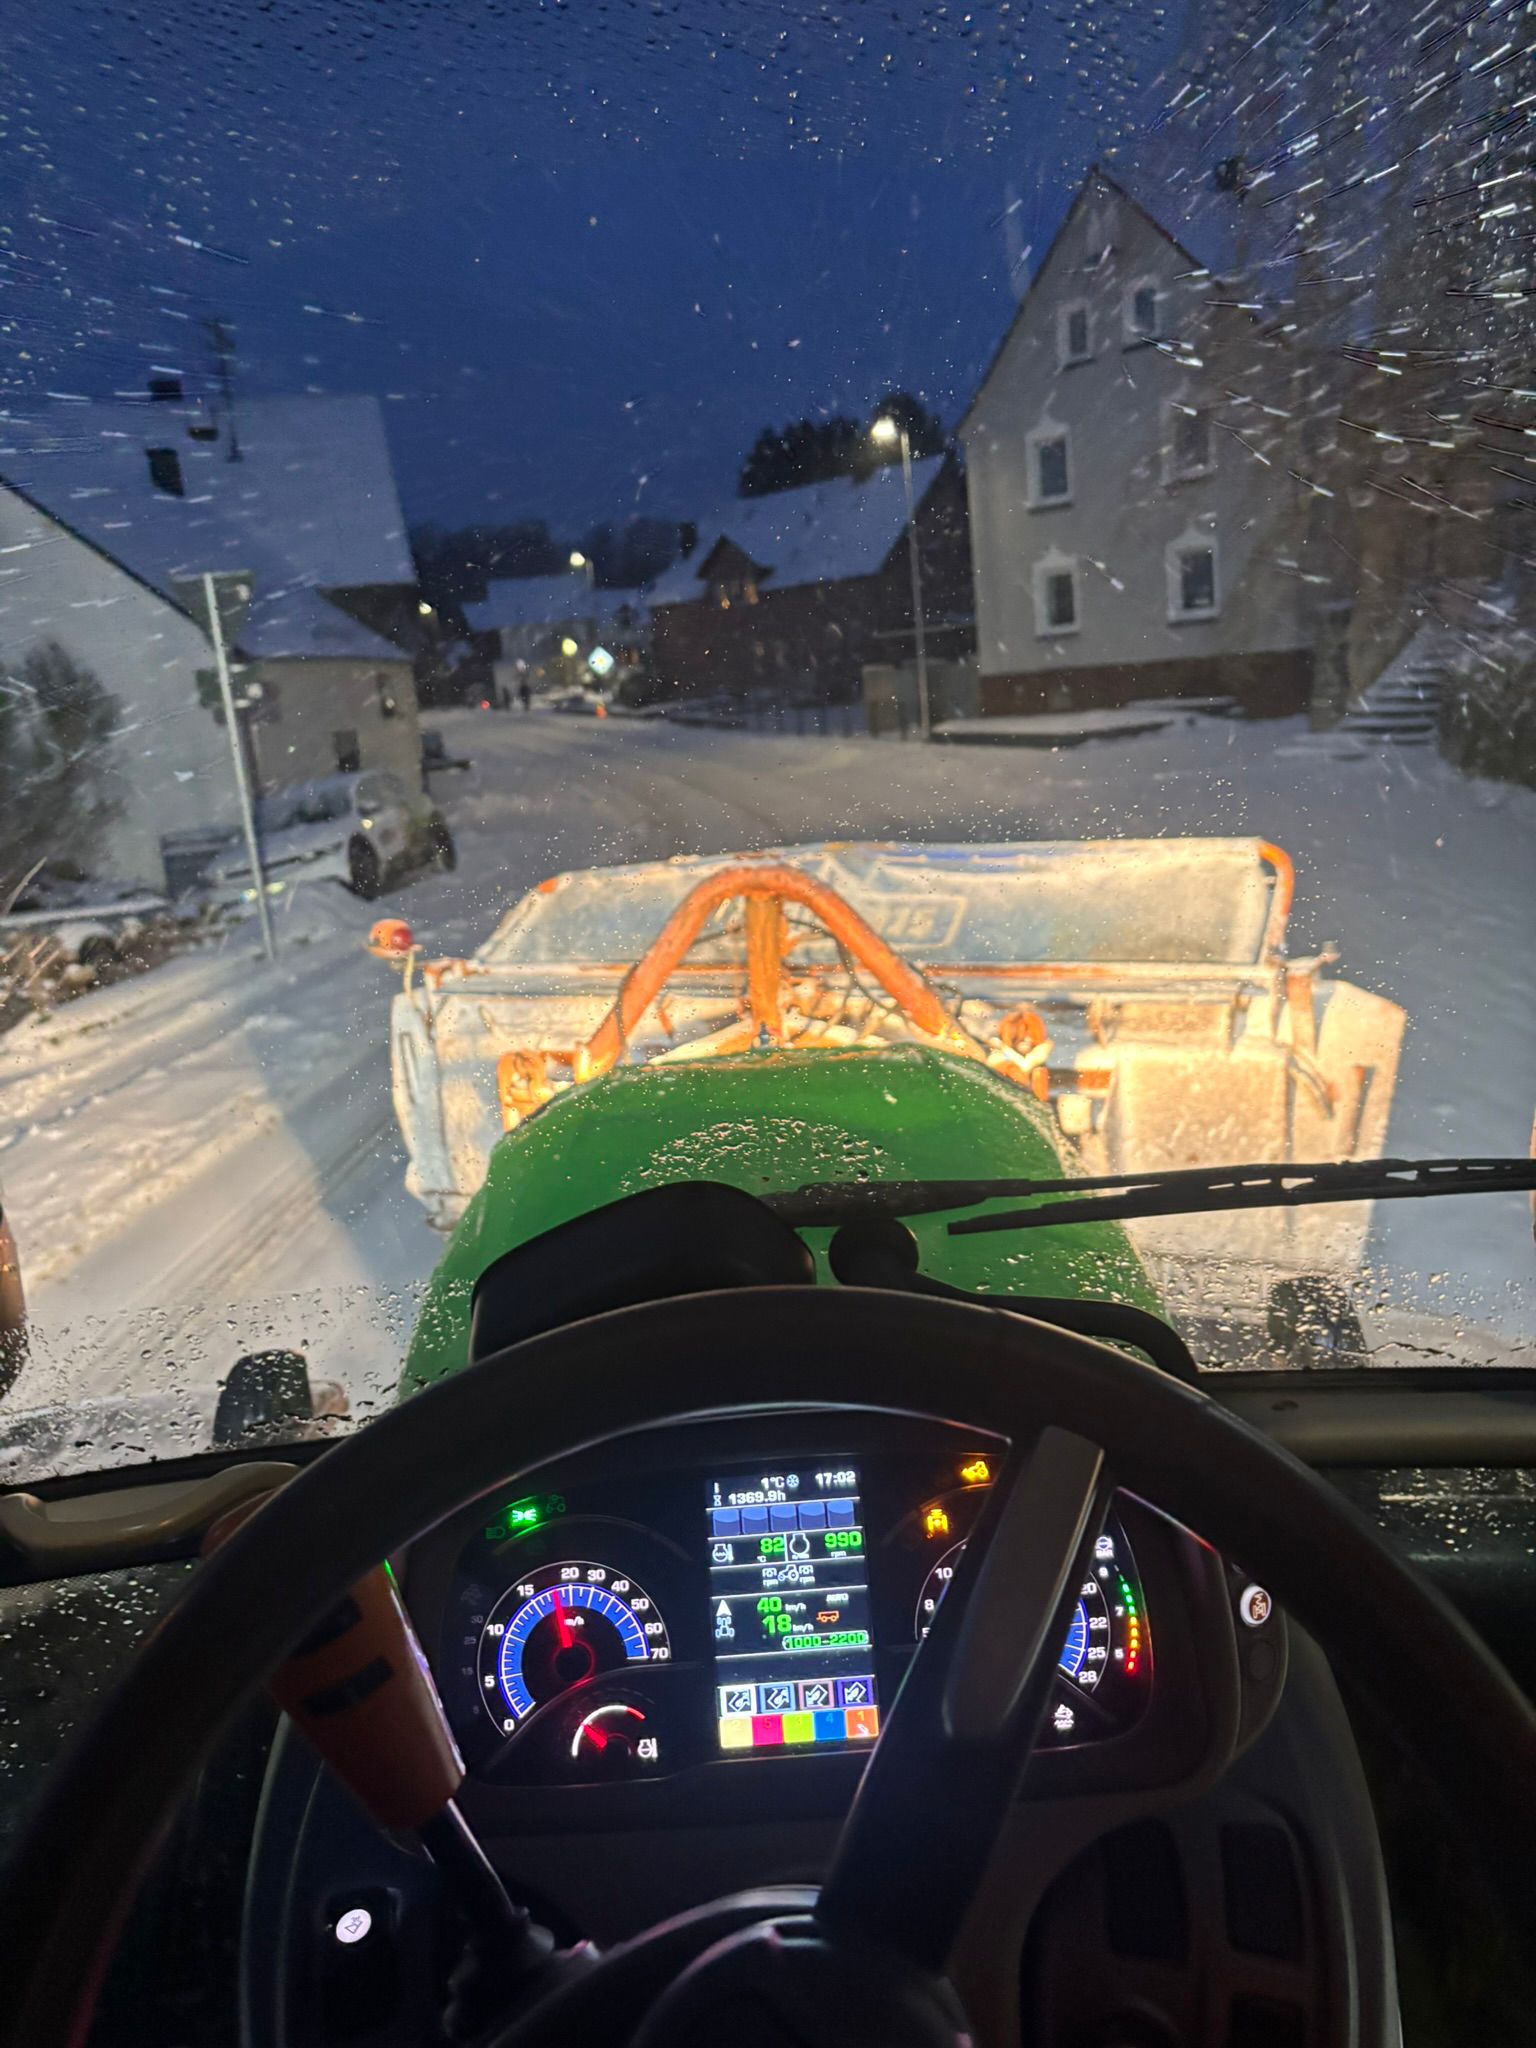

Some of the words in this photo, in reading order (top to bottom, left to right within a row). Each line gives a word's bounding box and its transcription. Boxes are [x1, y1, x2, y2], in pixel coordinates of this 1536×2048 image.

[815, 1471, 856, 1485] 17:02
[760, 1537, 785, 1554] 82
[824, 1531, 863, 1549] 990
[561, 1567, 580, 1580] 20
[587, 1569, 606, 1581] 30
[935, 1567, 953, 1579] 10
[1099, 1566, 1108, 1577] 9
[516, 1584, 535, 1596] 15
[611, 1580, 630, 1592] 40
[631, 1598, 649, 1610] 50
[756, 1597, 782, 1613] 40
[924, 1599, 934, 1611] 8
[1115, 1606, 1124, 1617] 7
[486, 1623, 505, 1635] 10
[645, 1622, 663, 1634] 60
[761, 1614, 792, 1634] 18
[1089, 1617, 1107, 1629] 22
[785, 1632, 866, 1649] 1000-2200
[651, 1647, 669, 1659] 70
[1087, 1647, 1106, 1659] 25
[1115, 1649, 1124, 1659] 5
[484, 1676, 495, 1688] 5
[1078, 1671, 1097, 1683] 28
[504, 1719, 515, 1731] 0
